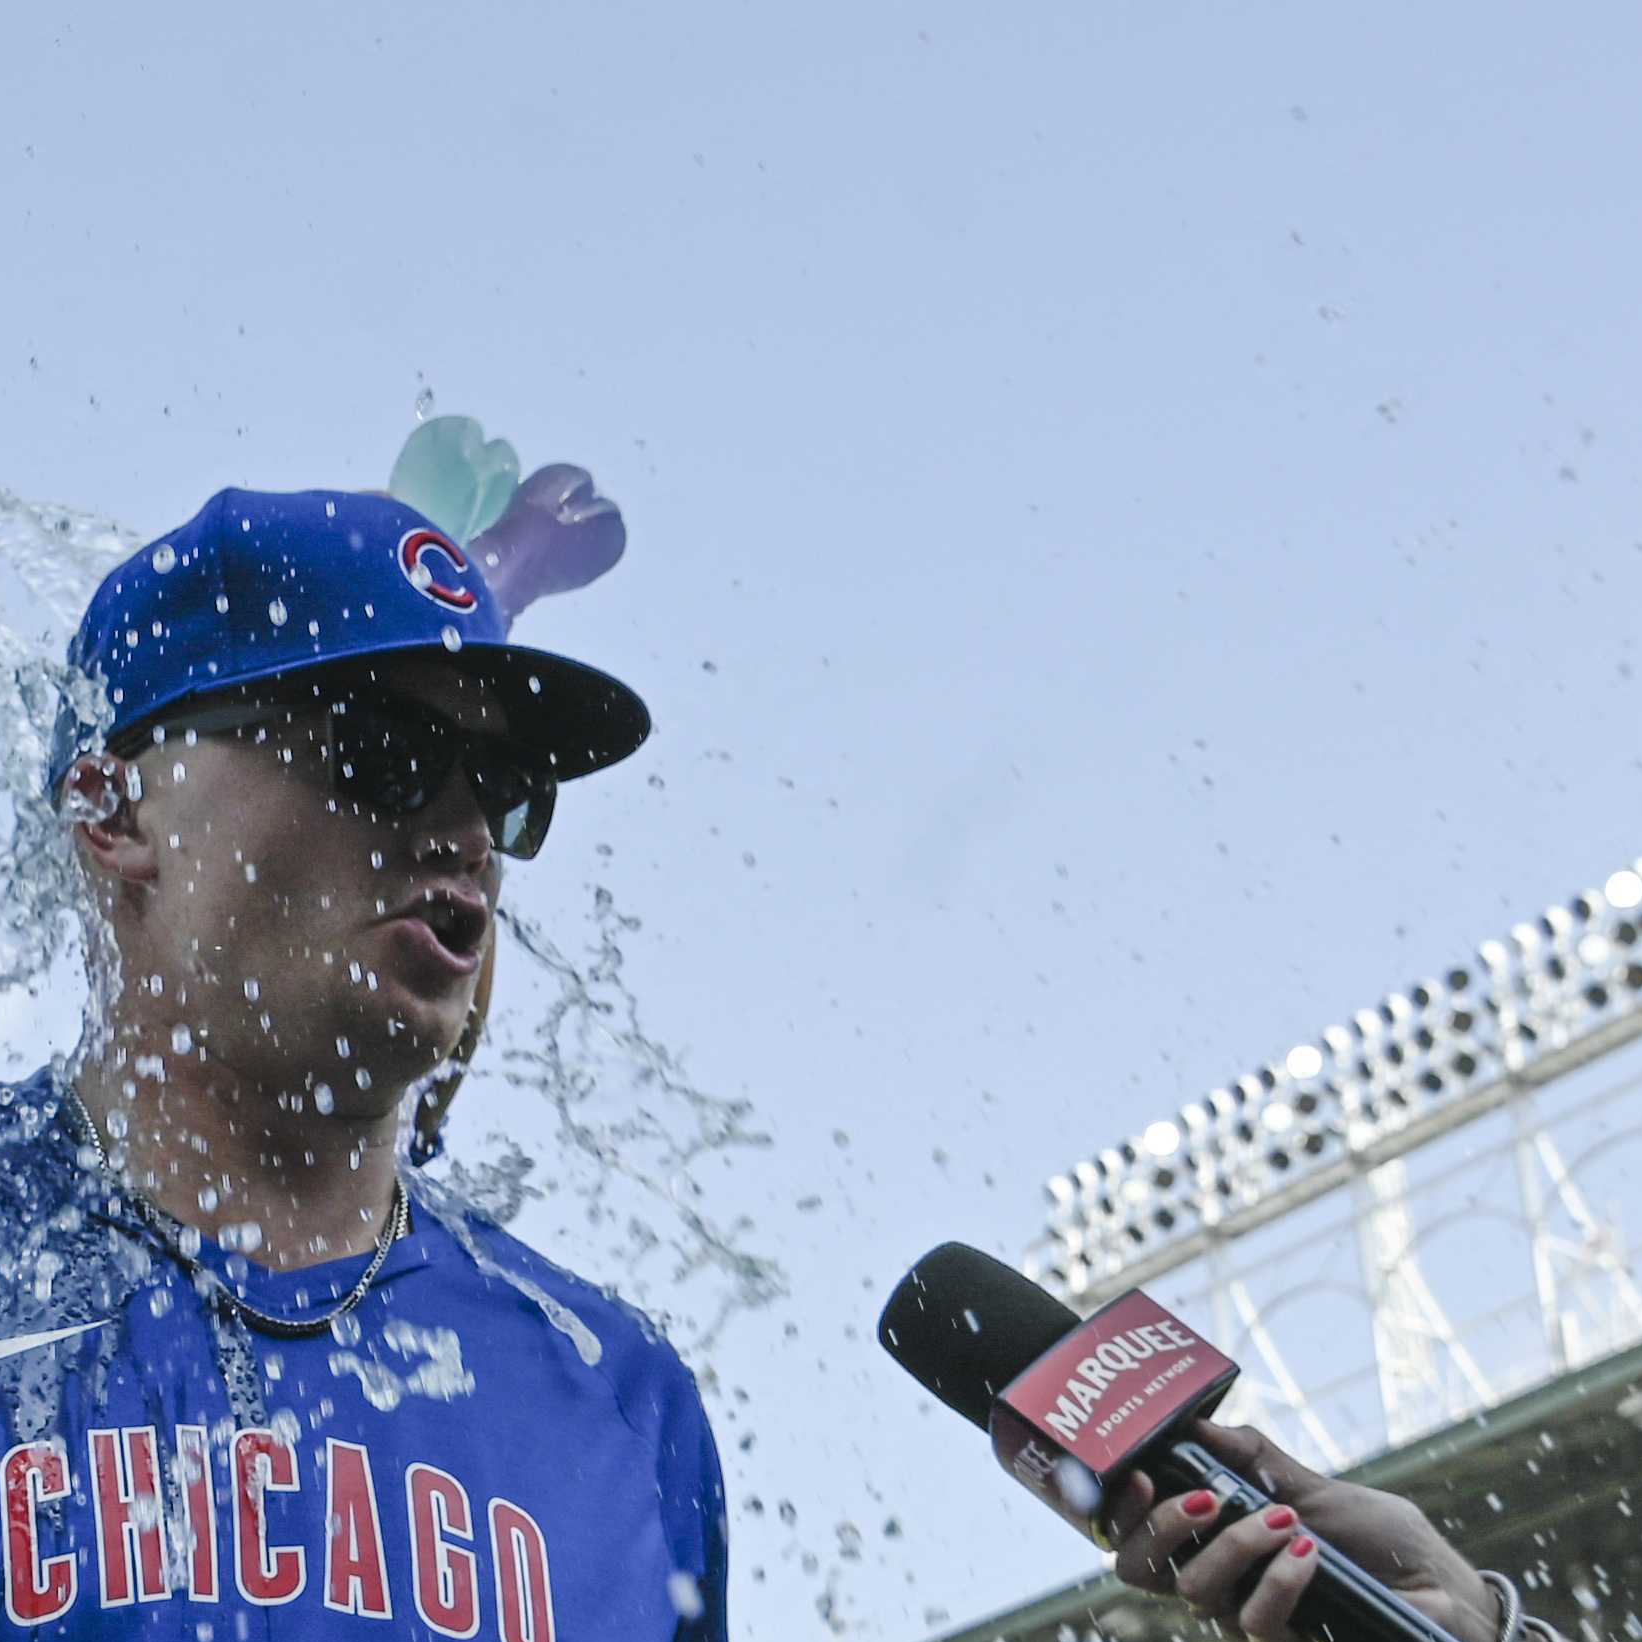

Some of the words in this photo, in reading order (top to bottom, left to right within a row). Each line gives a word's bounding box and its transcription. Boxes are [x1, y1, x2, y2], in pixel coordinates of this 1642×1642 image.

[398, 527, 478, 614] C
[1044, 1320, 1196, 1442] MARQUEE
[1096, 1395, 1144, 1437] SPORTS
[1143, 1354, 1198, 1396] NETWORK
